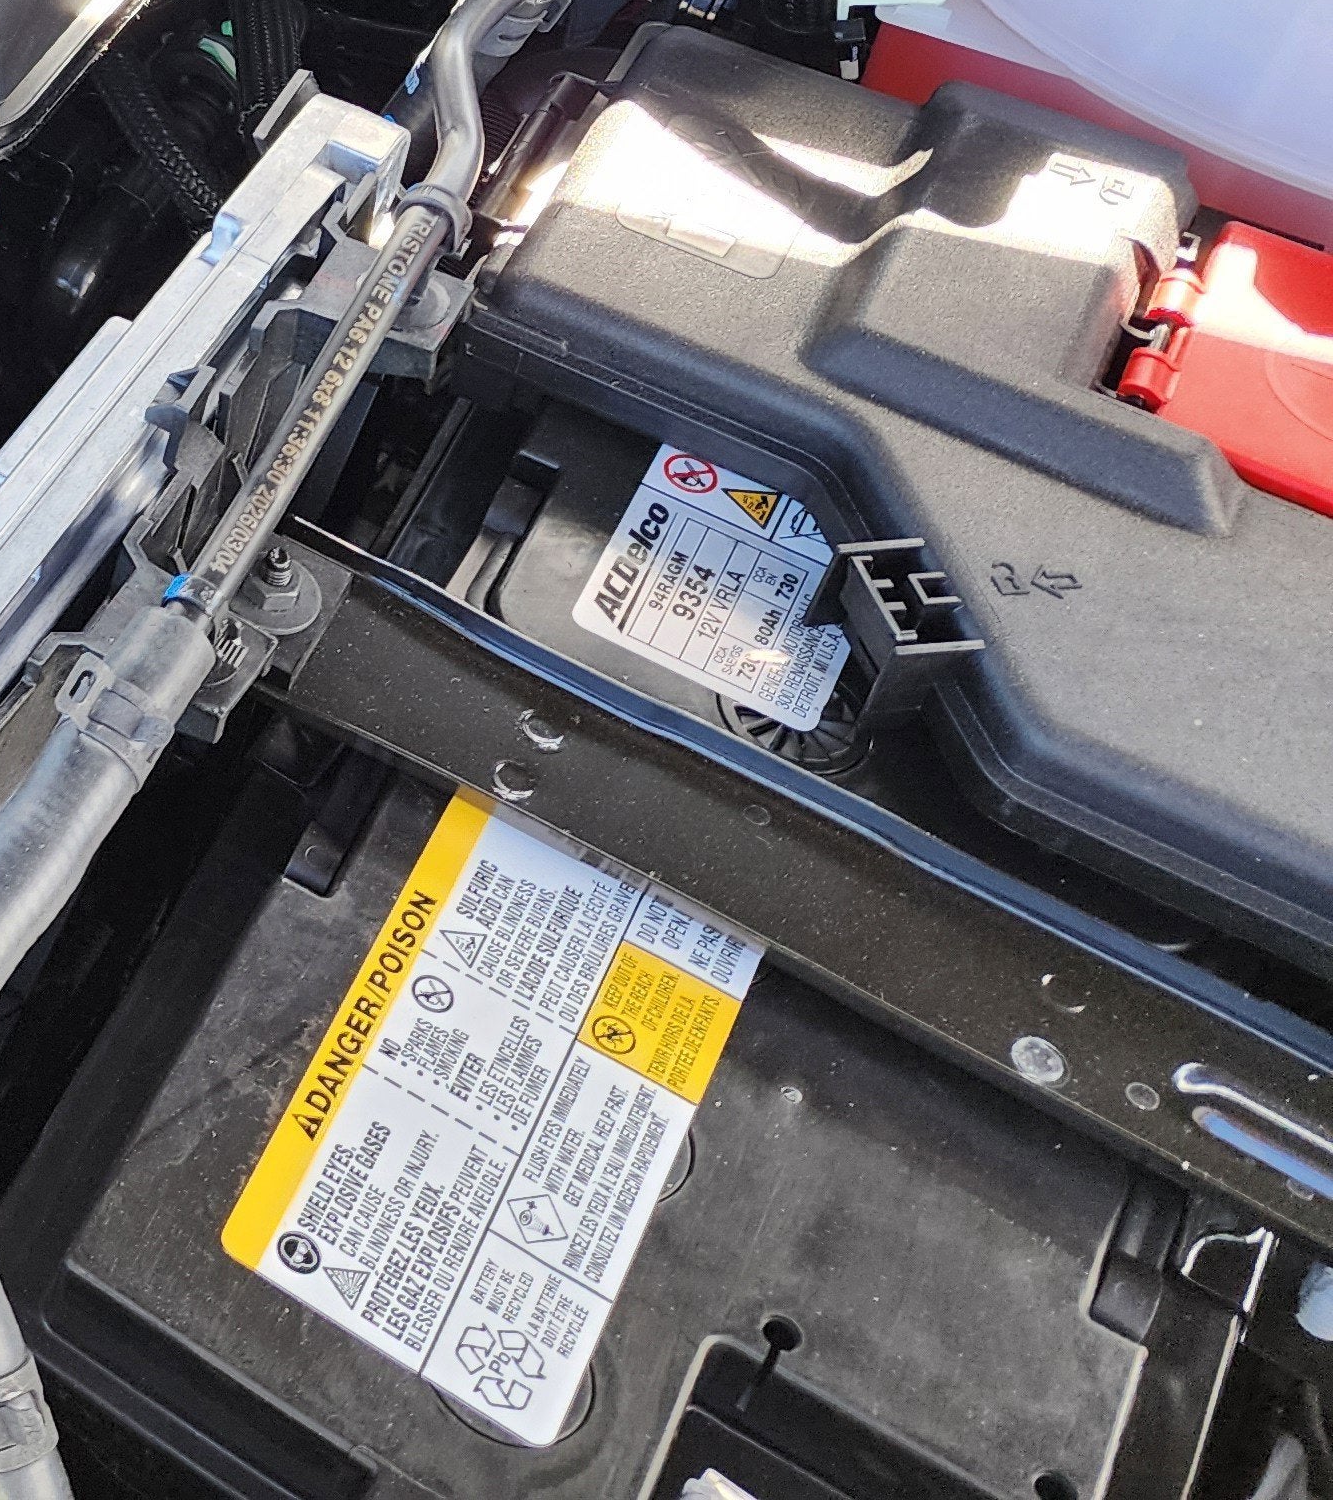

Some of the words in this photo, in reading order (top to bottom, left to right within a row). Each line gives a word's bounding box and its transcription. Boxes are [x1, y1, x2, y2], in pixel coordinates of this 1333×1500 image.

[371, 209, 437, 303] TRISTONE
[333, 303, 382, 369] PA6.12
[209, 482, 275, 575] 2026/03/04
[596, 502, 669, 619] ACDelco
[648, 550, 689, 609] 94RAGM
[752, 565, 768, 583] CCA
[765, 573, 777, 585] EN
[672, 564, 715, 619] 9354
[697, 610, 723, 639] 12V
[710, 570, 745, 609] VRLA
[774, 572, 799, 599] 730
[754, 609, 782, 645] 80Ah
[712, 646, 728, 664] CCA
[774, 688, 795, 710] 300
[792, 671, 825, 718] DETROIT,
[812, 658, 829, 673] MI
[455, 859, 498, 919] SULFURIC
[475, 896, 502, 930] ACID
[491, 873, 515, 900] CAN
[525, 888, 557, 928] BURNS.
[581, 879, 612, 921] CÉCITÉ
[476, 937, 507, 978] CAUSE
[494, 878, 536, 941] BLINDNESS
[504, 924, 538, 970] SEVERE
[514, 953, 550, 1001] L'ACIDE
[535, 885, 583, 957] SULFURIQUE
[573, 919, 595, 938] LA
[636, 922, 659, 944] DO
[553, 934, 587, 982] CAUSER
[577, 920, 618, 981] BRÛLURES
[620, 951, 638, 969] OF
[688, 948, 711, 970] NE
[496, 968, 516, 988] OR
[538, 978, 564, 1012] PEUT
[566, 978, 590, 1005] DES
[601, 983, 623, 1010] KEEP
[612, 964, 632, 987] OUT
[628, 969, 654, 1003] REACH
[305, 891, 435, 1112] DANGER/POISON
[558, 1001, 579, 1023] OU
[620, 998, 642, 1020] THE
[640, 1013, 658, 1032] OF
[670, 1006, 690, 1025] DE
[676, 995, 695, 1012] LA
[378, 1037, 401, 1060] NO
[400, 1017, 433, 1062] SPARKS
[416, 1025, 449, 1071] FLAMES
[433, 1028, 469, 1080] SMOKING
[483, 1015, 529, 1082] ÉTINCELLES
[658, 1021, 684, 1052] HORS
[445, 1052, 486, 1102] ÉVITER
[504, 1034, 542, 1092] FLAMMES
[646, 1047, 672, 1078] TENIR
[666, 1049, 696, 1091] PORTÉE
[682, 1035, 702, 1054] DE
[475, 1079, 499, 1106] LES
[493, 1089, 516, 1116] LES
[519, 1064, 550, 1108] FUMER
[604, 1084, 628, 1113] FAST.
[511, 1104, 531, 1126] DE
[522, 1144, 550, 1183] FLUSH
[537, 1119, 562, 1149] EYES
[550, 1056, 590, 1122] IMMEDIATELY
[592, 1109, 615, 1141] HELP
[402, 1129, 439, 1179] INJURY.
[449, 1143, 487, 1205] PEUVENT
[542, 1162, 567, 1194] WITH
[555, 1127, 584, 1166] WATER.
[572, 1139, 605, 1185] MEDICAL
[600, 1154, 625, 1186] L'EAU
[297, 1180, 334, 1232] SHIELD
[321, 1143, 356, 1184] EYES.
[317, 1165, 368, 1245] EXPLOSIVE
[354, 1121, 390, 1169] GASES
[393, 1176, 416, 1198] OR
[409, 1181, 445, 1222] YEUX.
[466, 1159, 507, 1220] AVEUGLE.
[562, 1181, 584, 1207] GET
[585, 1188, 610, 1218] YEUX
[593, 1179, 614, 1194] À
[612, 1169, 643, 1216] MÉDECIN
[338, 1225, 365, 1257] CAN
[352, 1183, 386, 1229] CAUSE
[358, 1196, 405, 1270] BLINDNESS
[396, 1220, 424, 1253] LES
[410, 1200, 460, 1280] EXPLOSIFS
[577, 1214, 599, 1238] LES
[606, 1210, 626, 1230] UN
[442, 1215, 479, 1271] RENDRE
[562, 1232, 591, 1271] RINCEZ
[583, 1225, 619, 1283] CONSULTEZ
[360, 1247, 411, 1326] PROTÉGEZ
[396, 1275, 426, 1310] GAZ
[433, 1267, 455, 1291] OU
[469, 1257, 498, 1305] BATTERY
[486, 1282, 507, 1314] MUST
[499, 1268, 515, 1285] BE
[502, 1271, 534, 1323] RECYCLED
[531, 1273, 561, 1323] BATTERIE
[381, 1307, 411, 1341] LES
[404, 1289, 445, 1352] BLESSER
[525, 1321, 540, 1338] LA
[540, 1319, 559, 1348] DOIT
[550, 1293, 573, 1323] ÊTRE
[556, 1304, 589, 1358] RECYCLÉE
[488, 1351, 511, 1376] Pb
